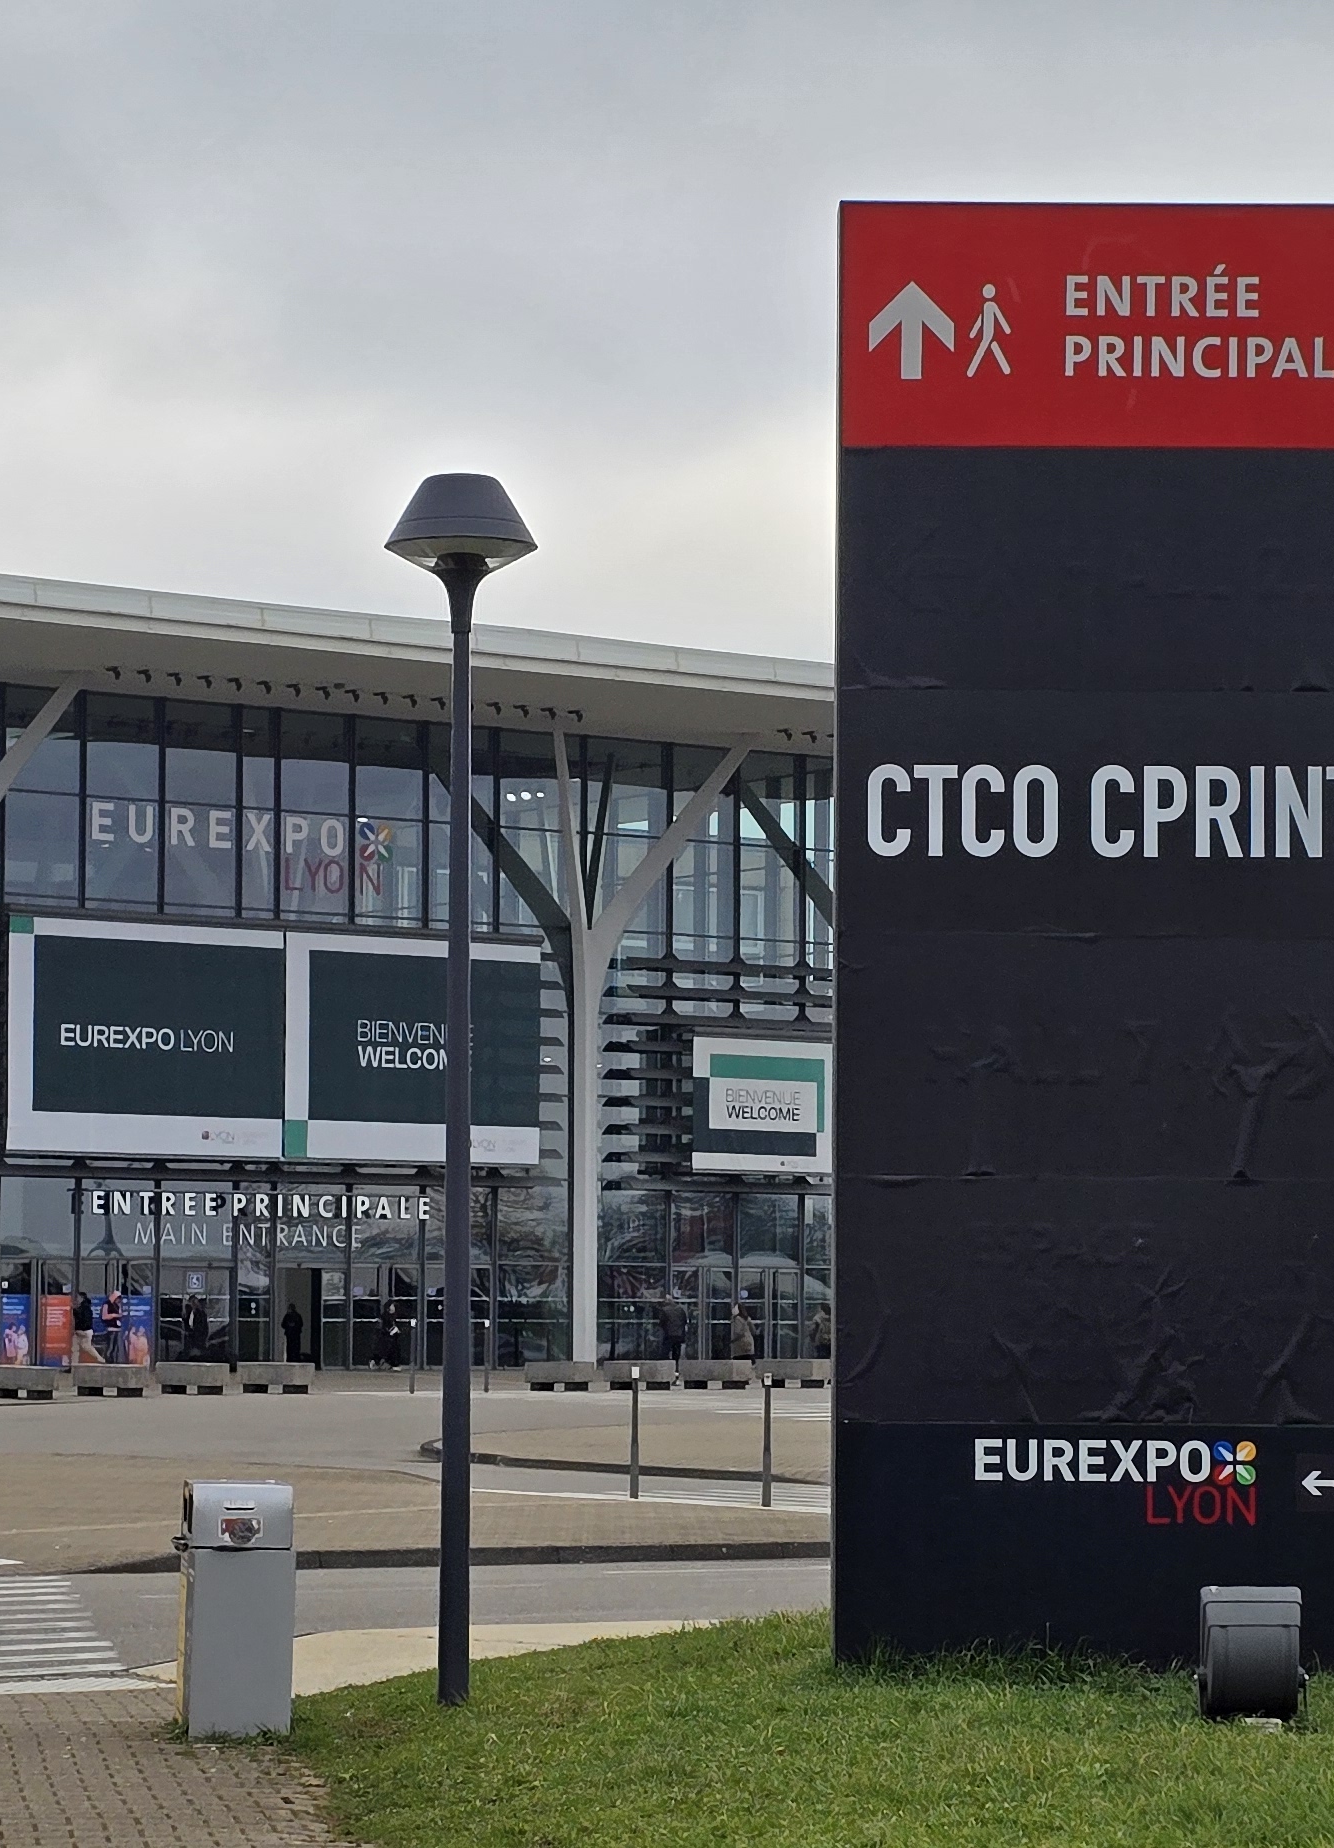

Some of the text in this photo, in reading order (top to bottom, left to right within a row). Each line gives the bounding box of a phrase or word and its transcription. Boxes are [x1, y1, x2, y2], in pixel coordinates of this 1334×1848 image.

[1064, 264, 1260, 318] ENTRÉE
[867, 763, 1059, 858] CTCO
[90, 801, 345, 857] EUREXPO
[284, 857, 382, 896] LYON
[60, 1023, 234, 1053] EUREXPO LYON
[357, 1019, 474, 1047] BIENVEN
[357, 1045, 473, 1073] WELCO
[725, 1087, 802, 1107] BIENVENUE
[726, 1104, 801, 1122] WELCOME
[91, 1190, 431, 1220] ENTREE PRINCIPALE
[134, 1221, 362, 1248] MAIN ENTRANCE
[974, 1438, 1211, 1483] EUREXPO
[1145, 1485, 1257, 1526] LYON
